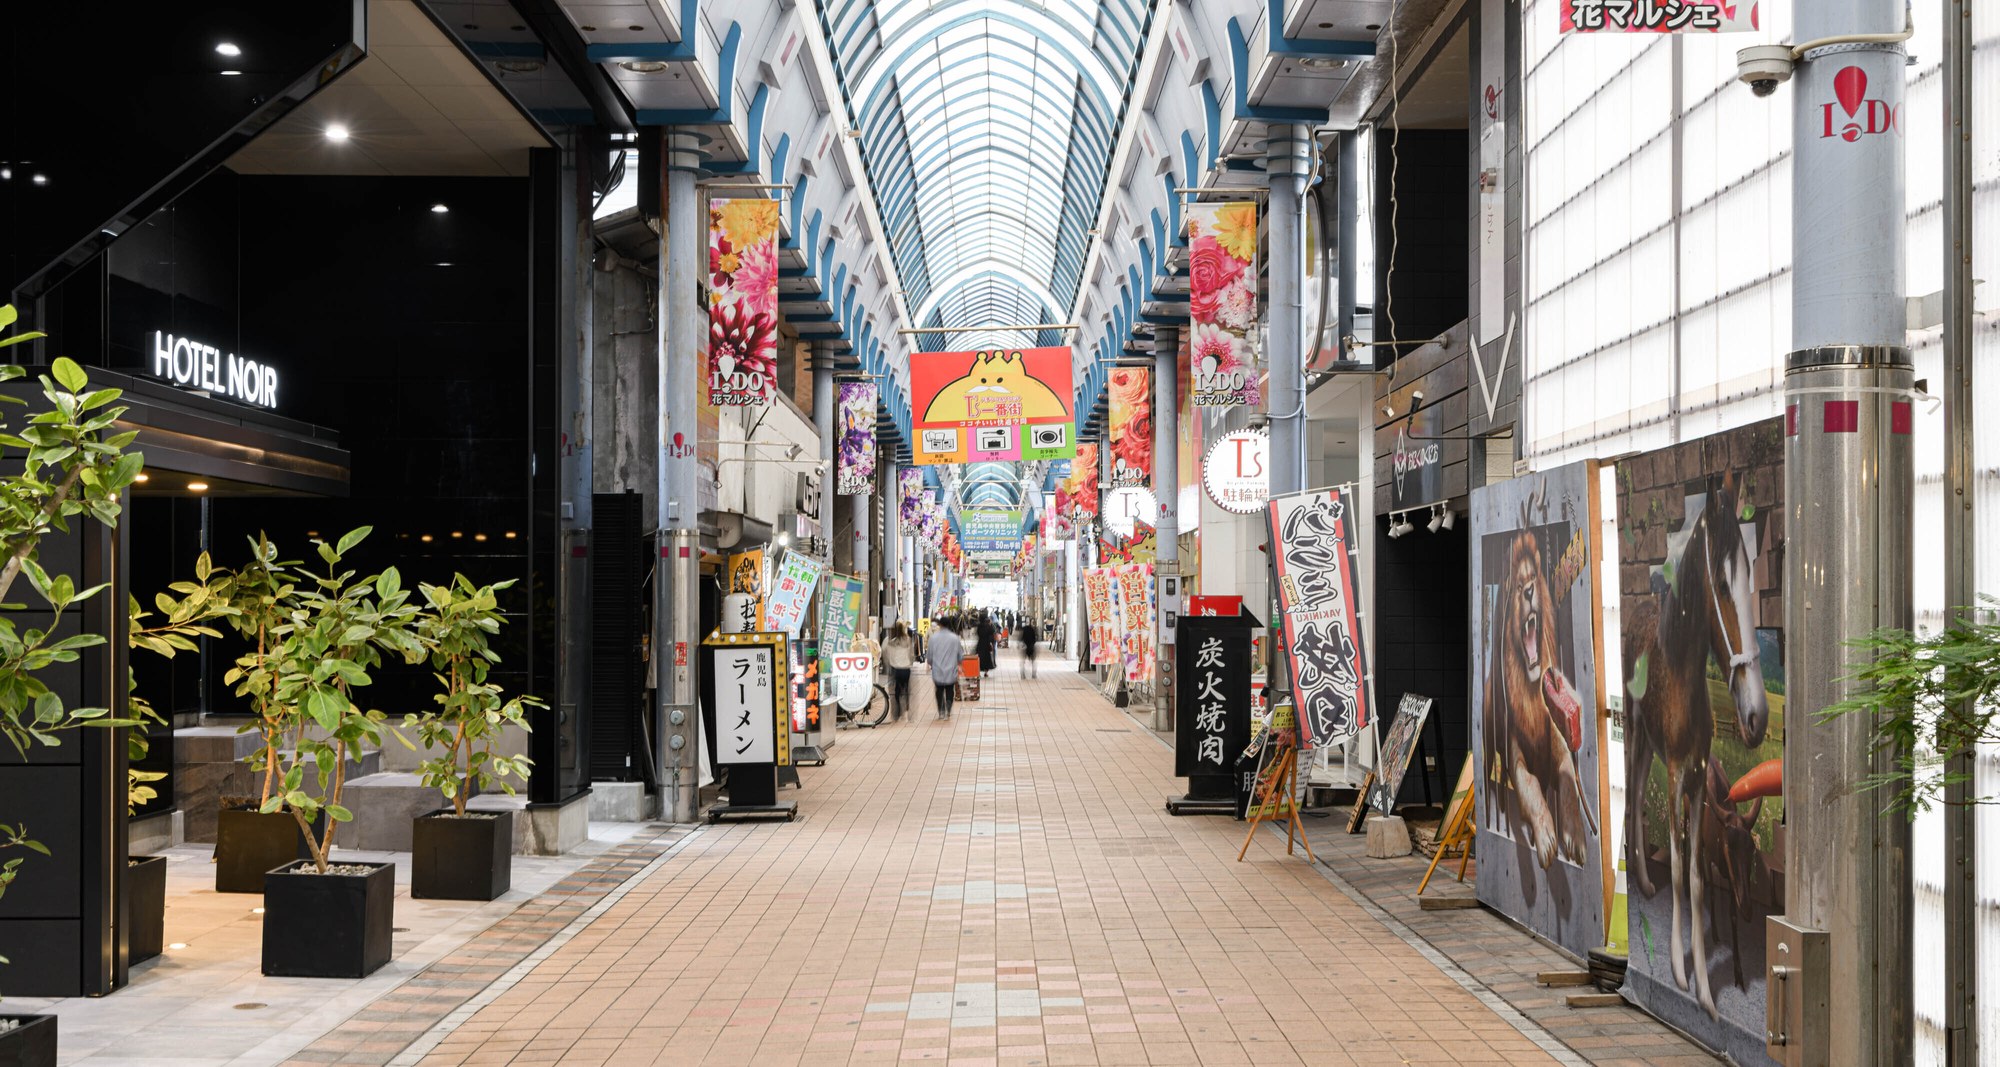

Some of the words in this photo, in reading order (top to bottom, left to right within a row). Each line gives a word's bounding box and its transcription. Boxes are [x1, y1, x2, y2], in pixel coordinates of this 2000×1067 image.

[1571, 0, 1720, 30] 花マルシェ
[155, 330, 226, 393] HOTEL
[228, 353, 277, 408] NOIR
[712, 393, 764, 406] 花マルシェ
[1194, 393, 1246, 406] 花マルシェ
[965, 528, 1018, 536] スポーツクリニック
[1088, 574, 1114, 651] 営業中
[1121, 571, 1151, 665] 営業中
[756, 652, 767, 687] 鹿児島
[806, 659, 819, 725] メガネ
[1196, 637, 1226, 766] 炭火焼肉
[732, 658, 754, 755] ラーメン
